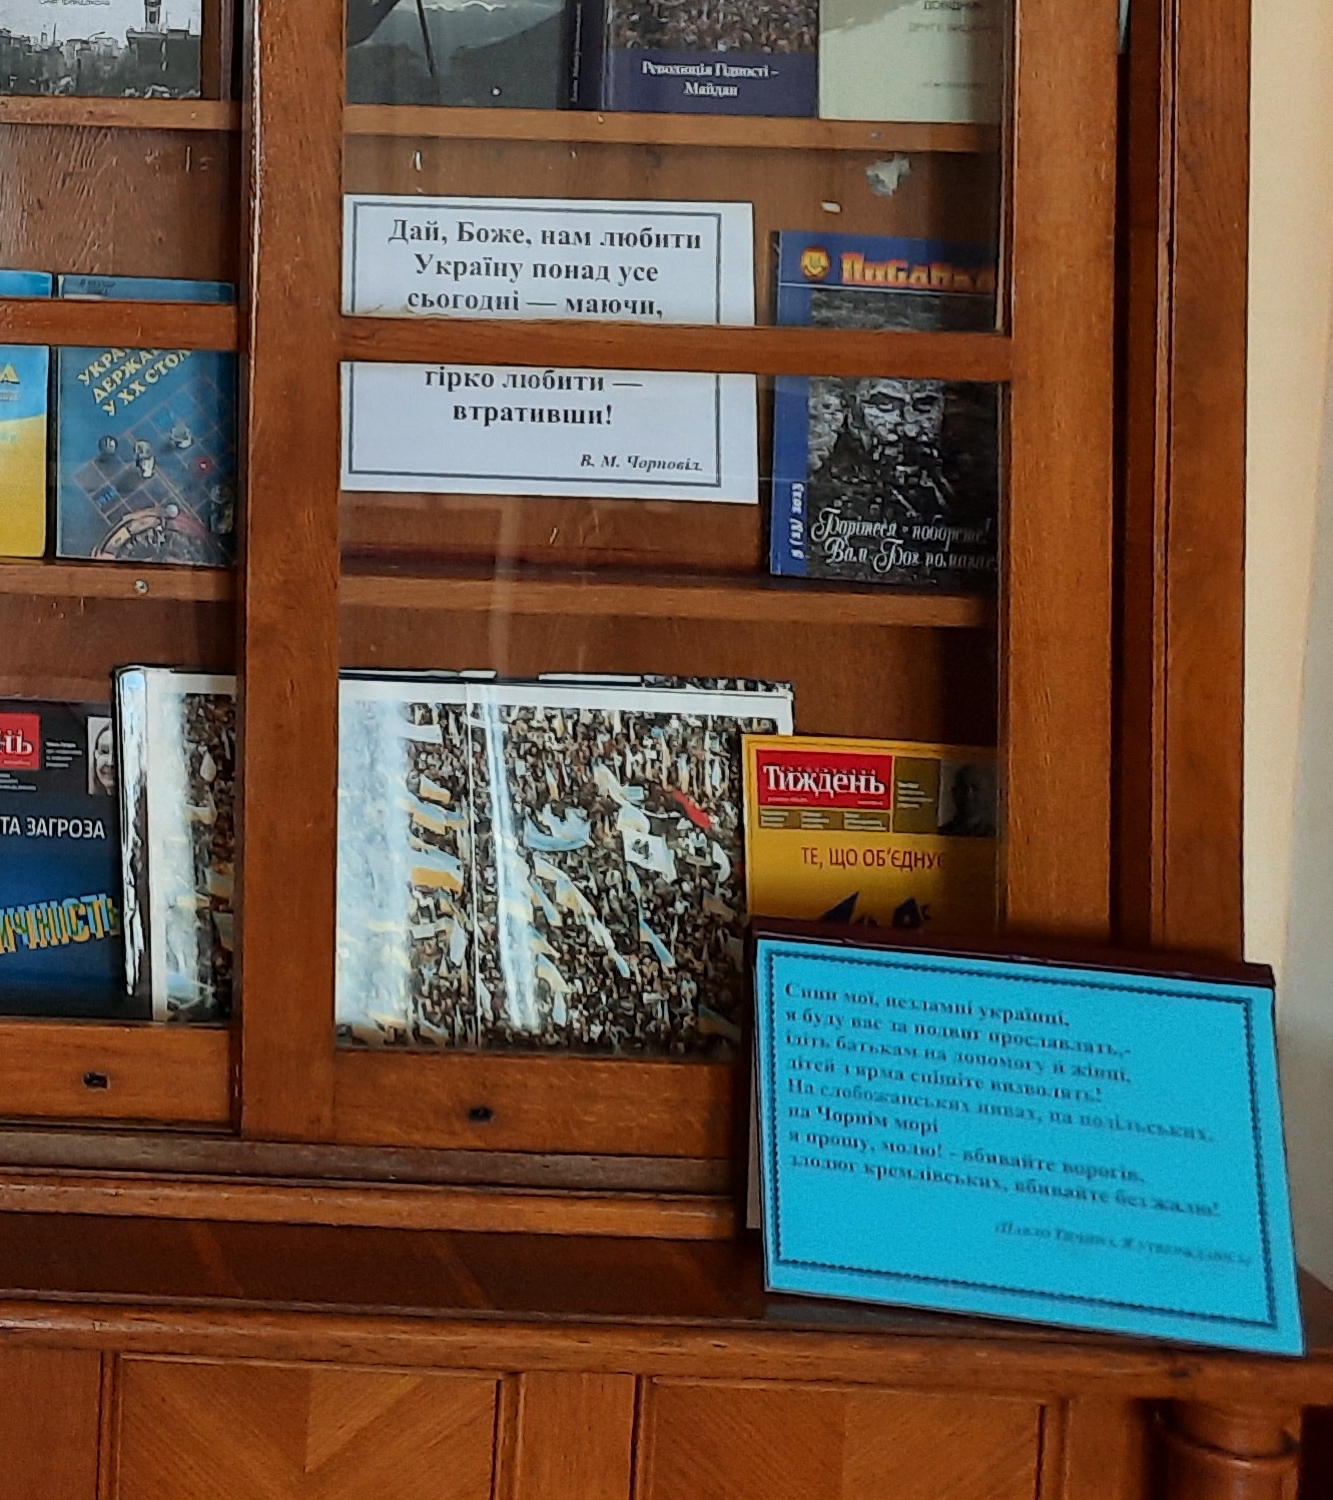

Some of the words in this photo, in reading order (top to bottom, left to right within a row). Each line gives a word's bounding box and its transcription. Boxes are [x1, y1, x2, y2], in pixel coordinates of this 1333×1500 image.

[387, 219, 448, 244] Дай,
[456, 221, 532, 245] Боже,
[540, 229, 591, 246] нам
[600, 229, 701, 249] любити
[414, 253, 523, 283] Україну
[532, 261, 611, 283] понад
[618, 265, 659, 286] усе
[407, 291, 520, 313] сьогодні
[565, 297, 664, 319] маючи,
[424, 366, 495, 392] гірко
[501, 371, 604, 392] любити
[102, 400, 116, 417] У
[453, 403, 613, 427] втративши!
[580, 454, 595, 468] В.
[601, 455, 621, 469] М.
[626, 455, 703, 473] Чорновіл
[762, 765, 886, 798] Тиждень
[25, 817, 106, 840] ЗАГРОЗА
[801, 846, 823, 870] ТЕ,
[829, 848, 857, 869] ЩО
[785, 982, 838, 1000] Сини
[886, 996, 973, 1016] незламні
[803, 1008, 844, 1028] буду
[851, 1017, 882, 1029] вас
[836, 1036, 917, 1058] батькам
[788, 1078, 814, 1095] На
[818, 1106, 888, 1128] Чорнім
[895, 1117, 939, 1136] морі
